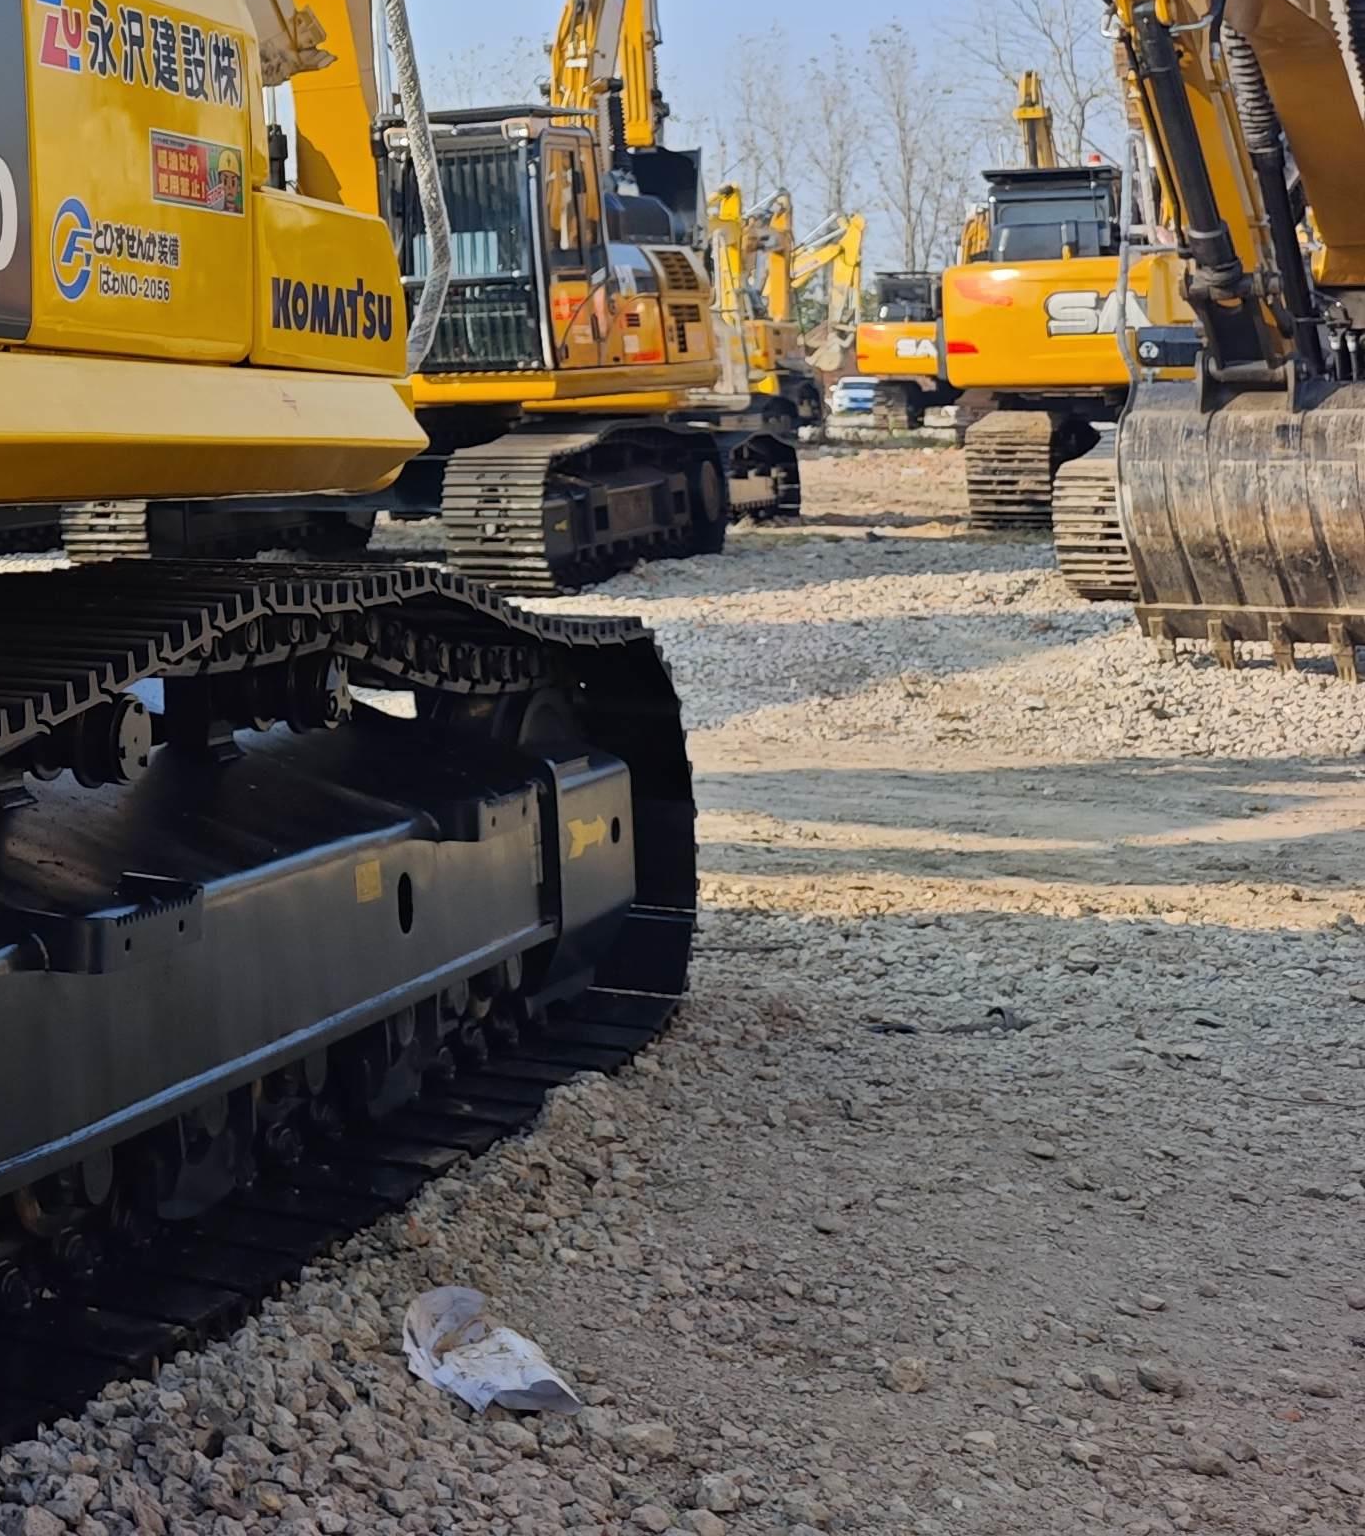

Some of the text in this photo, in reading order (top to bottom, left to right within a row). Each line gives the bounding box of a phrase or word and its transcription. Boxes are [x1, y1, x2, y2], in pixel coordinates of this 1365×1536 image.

[271, 277, 392, 342] KOMATSU
[1044, 289, 1153, 337] SA
[895, 337, 938, 359] SA
